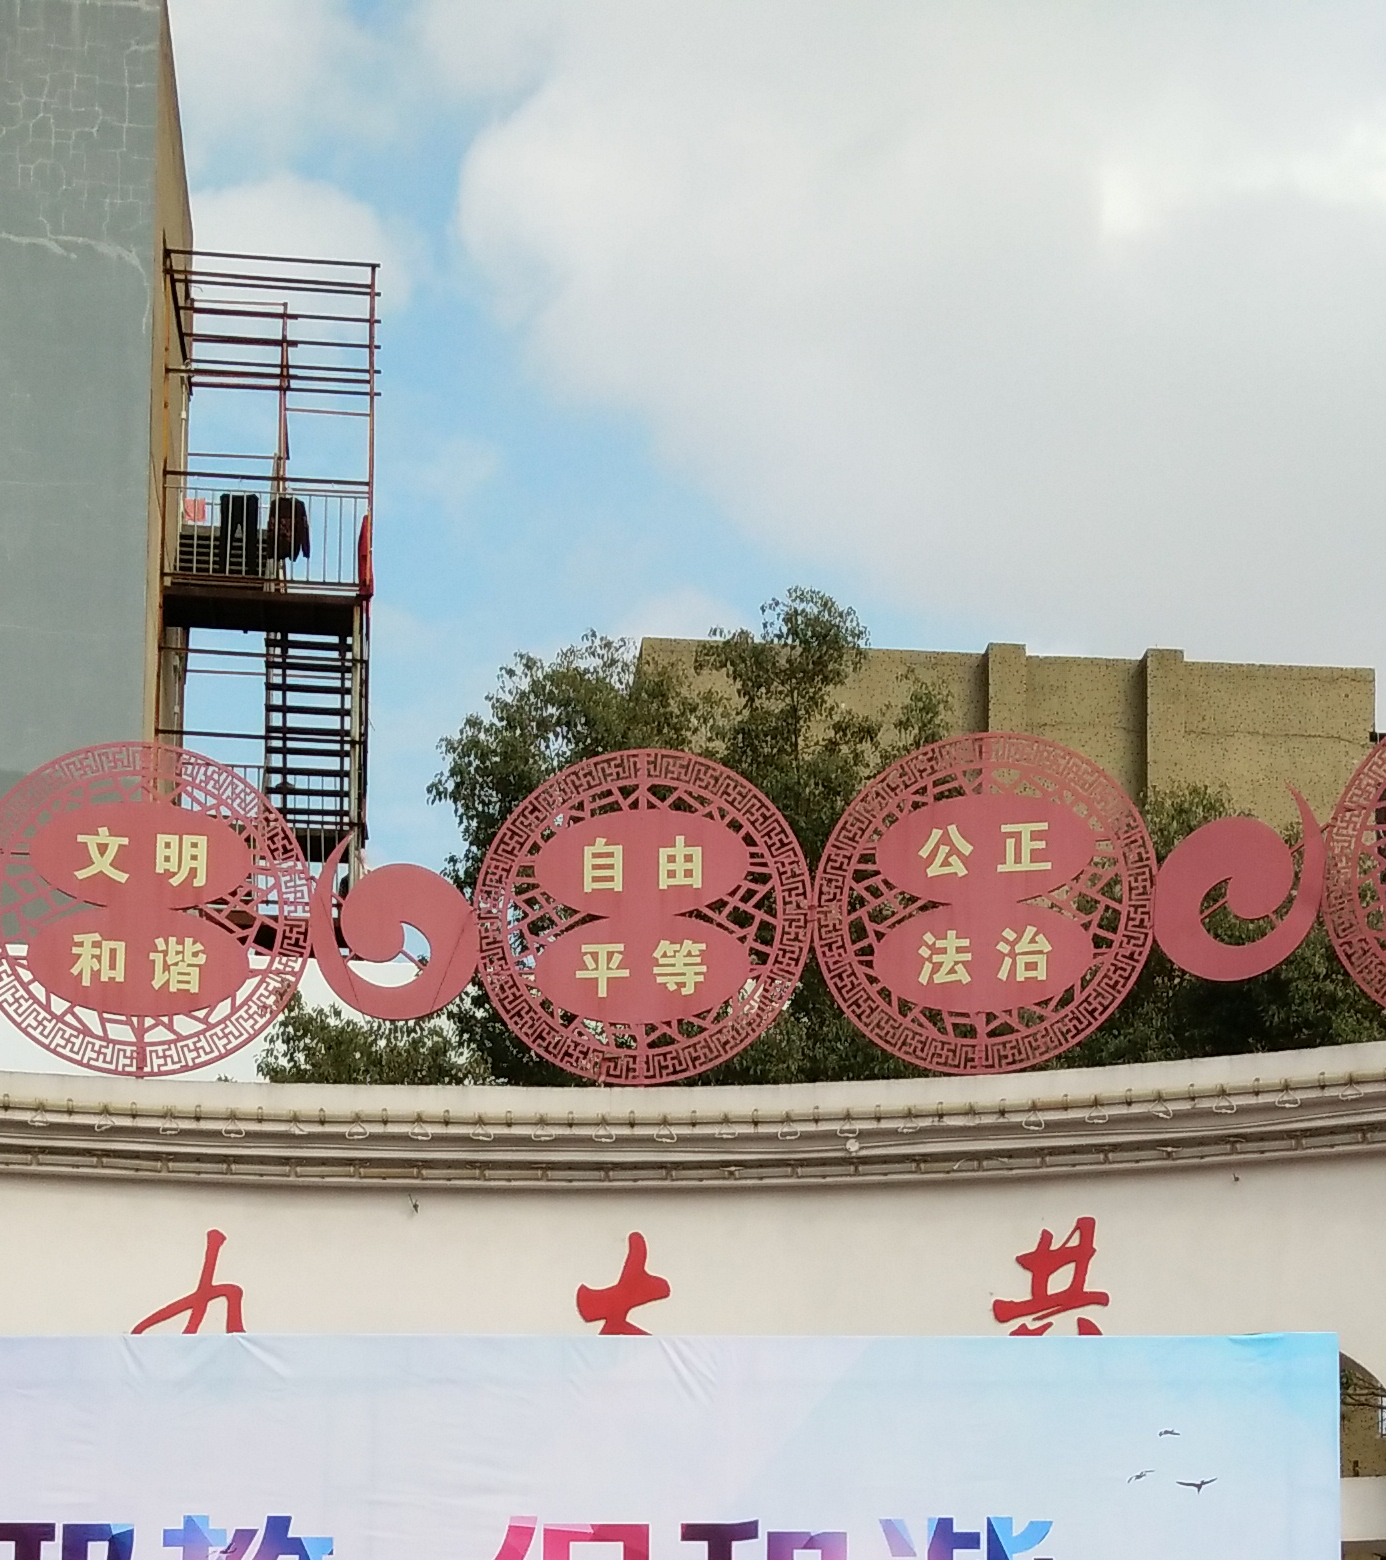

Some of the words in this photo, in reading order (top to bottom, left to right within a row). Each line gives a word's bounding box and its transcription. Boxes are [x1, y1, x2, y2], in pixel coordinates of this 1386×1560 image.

[74, 826, 209, 888] 文明
[582, 835, 703, 894] 自由
[918, 822, 1053, 879] 公正
[71, 932, 208, 993] 和谐
[575, 939, 707, 998] 平等
[918, 926, 1053, 986] 法治
